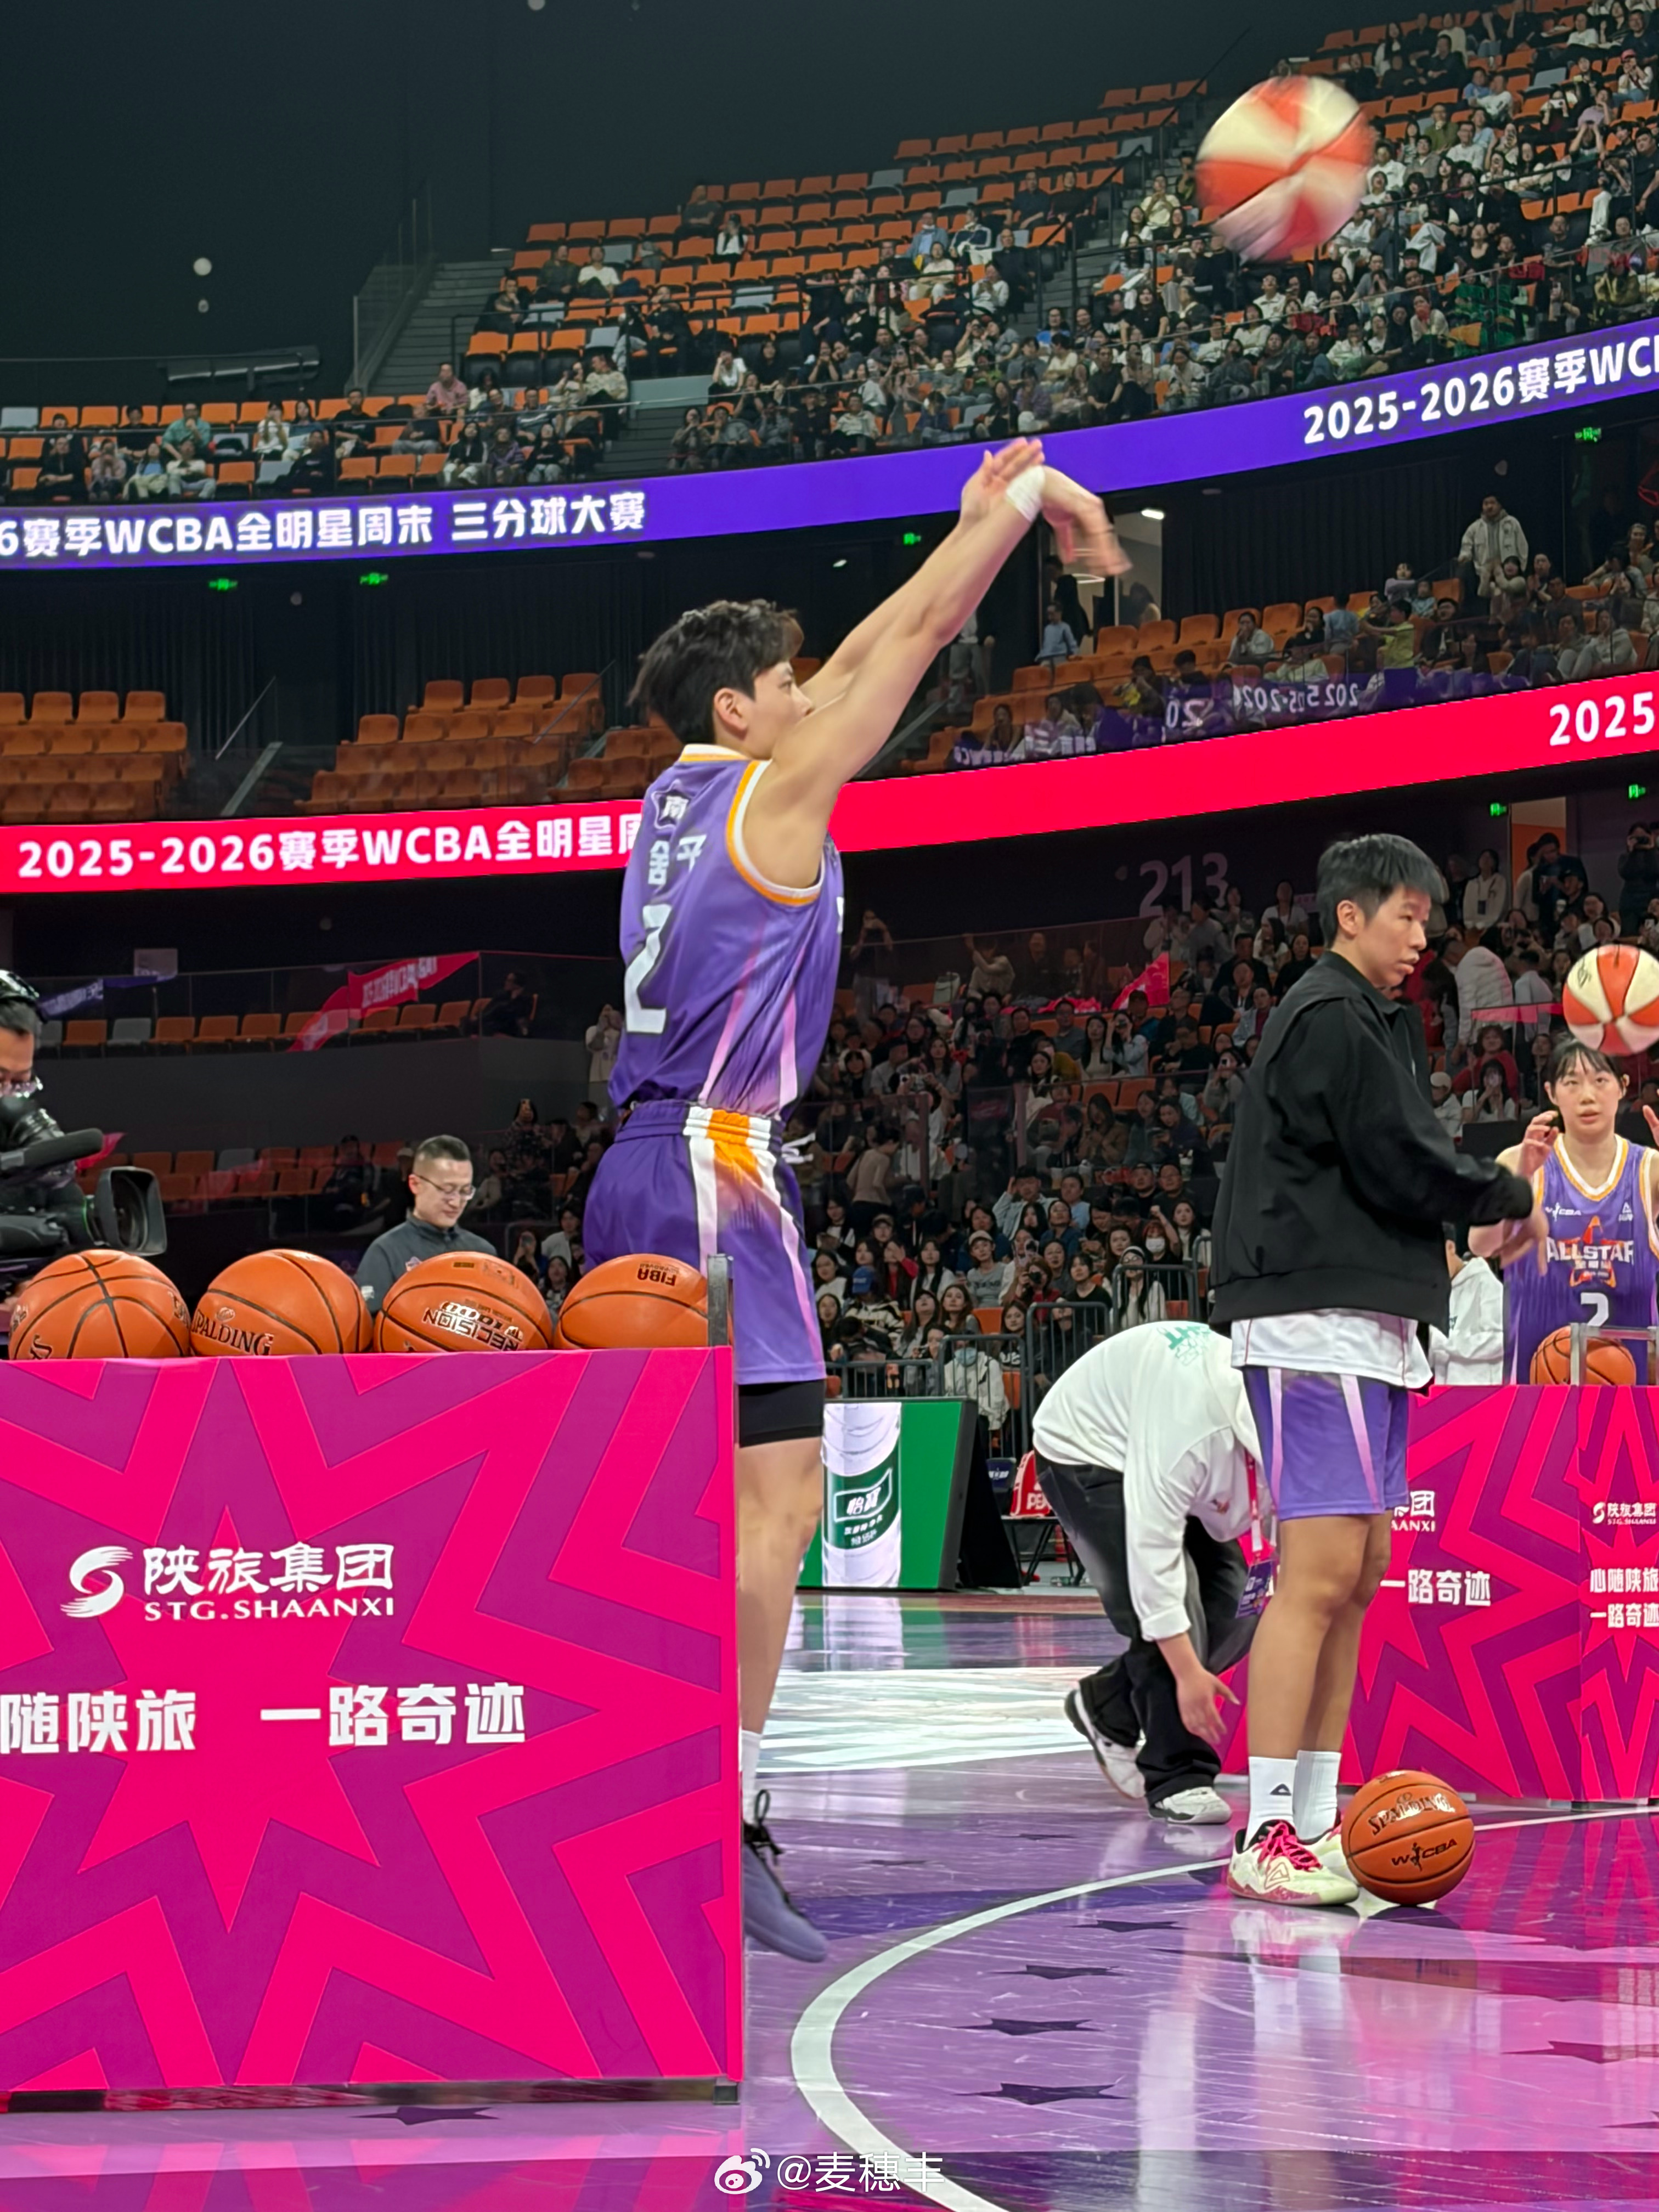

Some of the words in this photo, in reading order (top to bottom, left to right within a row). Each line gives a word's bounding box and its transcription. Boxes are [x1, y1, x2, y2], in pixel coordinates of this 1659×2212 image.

[1304, 334, 1659, 444] 2025-2026赛季WC
[451, 491, 645, 541] 三分球大赛
[1549, 691, 1655, 746] 2025
[1139, 853, 1229, 917] 213
[624, 903, 673, 1034] 2
[637, 1268, 677, 1286] FIBA
[191, 1308, 274, 1356] PALDING
[422, 1307, 519, 1351] RECISION
[143, 1541, 394, 1595] 陕旅集团
[1380, 1568, 1491, 1607] 一路奇迹
[1589, 1567, 1659, 1593] 心随陕旅
[145, 1596, 394, 1621] STG.SHAANXI
[1590, 1602, 1659, 1628] 一路奇迹
[0, 1689, 196, 1754] 随陕旅
[260, 1681, 526, 1747] 一路奇迹
